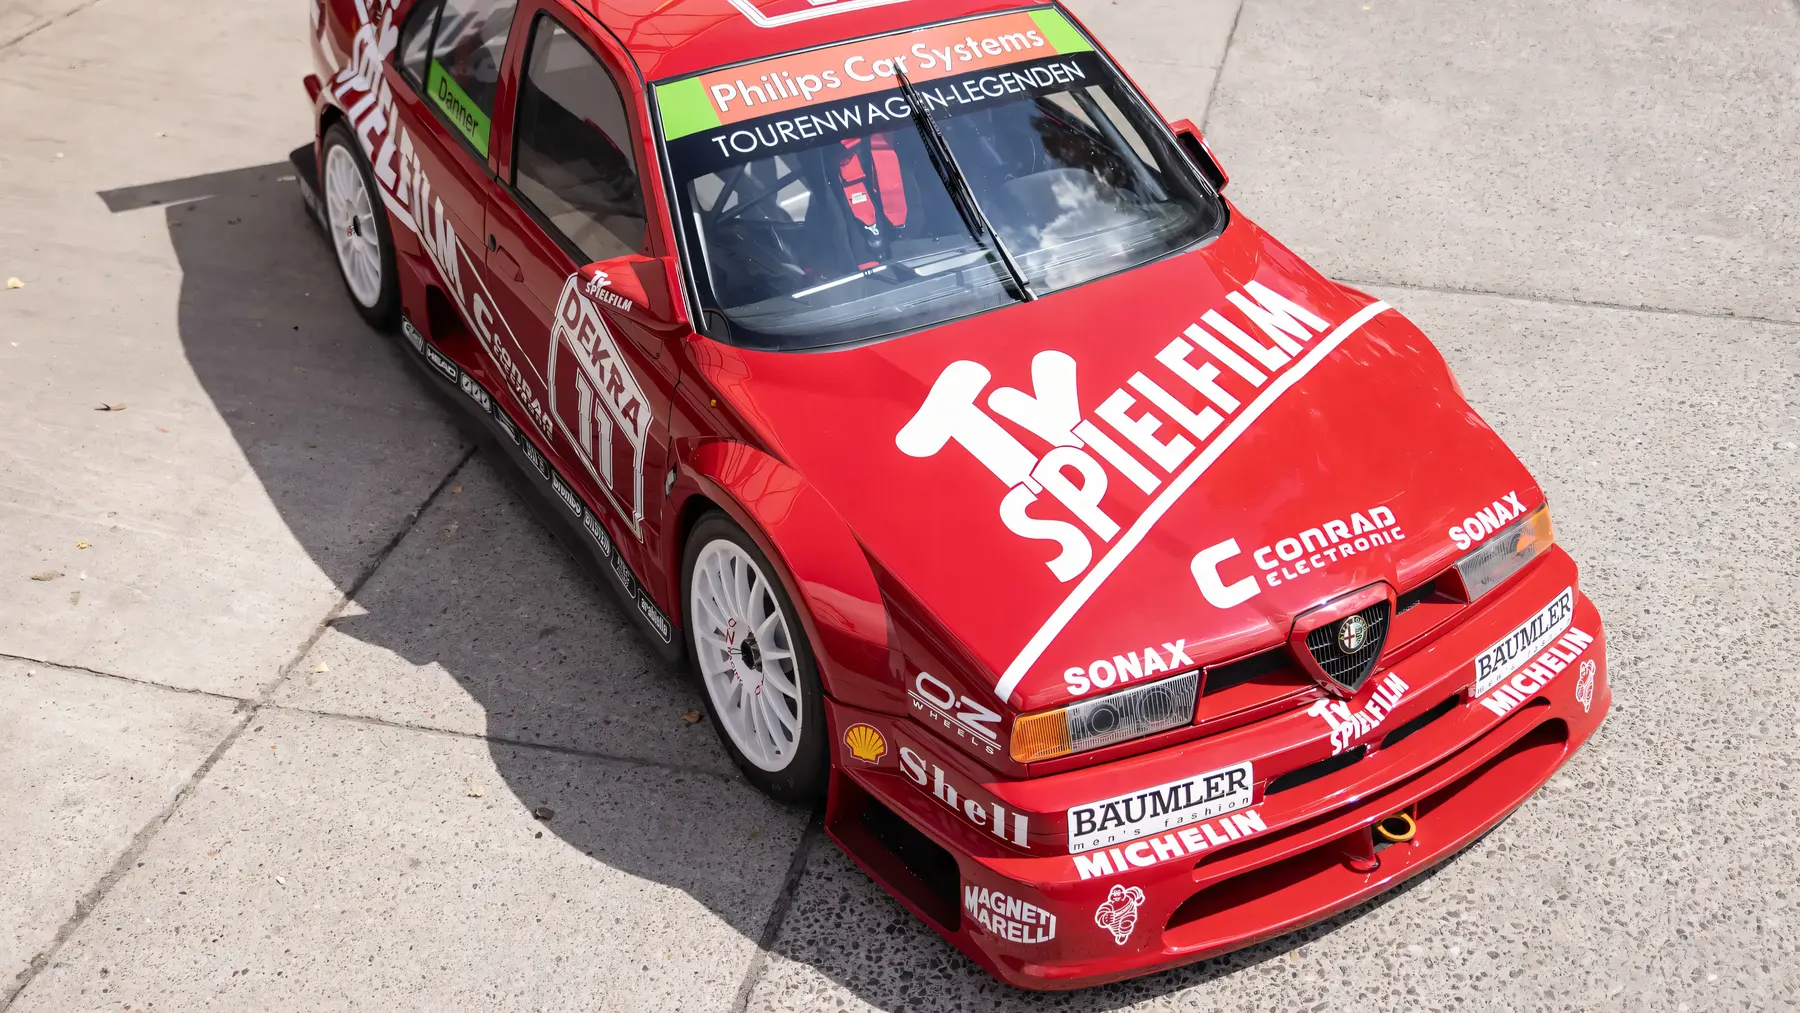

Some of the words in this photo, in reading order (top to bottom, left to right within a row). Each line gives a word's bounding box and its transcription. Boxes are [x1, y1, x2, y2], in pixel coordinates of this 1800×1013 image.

[710, 71, 842, 112] Philips
[844, 55, 908, 81] Car
[912, 30, 1044, 71] Systems
[439, 76, 478, 137] Danner
[712, 61, 1086, 157] TOURENWAGN-LEGENDEN
[585, 282, 633, 312] SPIELFILM
[427, 349, 456, 377] HEAD
[562, 287, 640, 438] DEKRA
[575, 367, 613, 490] 11
[896, 349, 1083, 490] TV
[999, 279, 1331, 583] SPIELFILM
[1253, 506, 1396, 570] CONRAD
[1449, 491, 1528, 551] SONAX
[1266, 526, 1405, 587] ELECTRONIC
[1064, 639, 1194, 695] SONAX
[1478, 593, 1571, 681] BÄUMLER
[1480, 626, 1594, 717] MICHELIN
[912, 698, 994, 755] WHEELS
[1307, 697, 1352, 732] TV
[1330, 672, 1409, 757] SPIELFILM
[900, 747, 1031, 849] Shell
[1073, 767, 1249, 837] BÄUMLER
[1073, 828, 1141, 851] men's
[1165, 796, 1249, 828] fashion
[1073, 810, 1267, 880] MICHELIN
[965, 886, 1056, 928] MAGNETI
